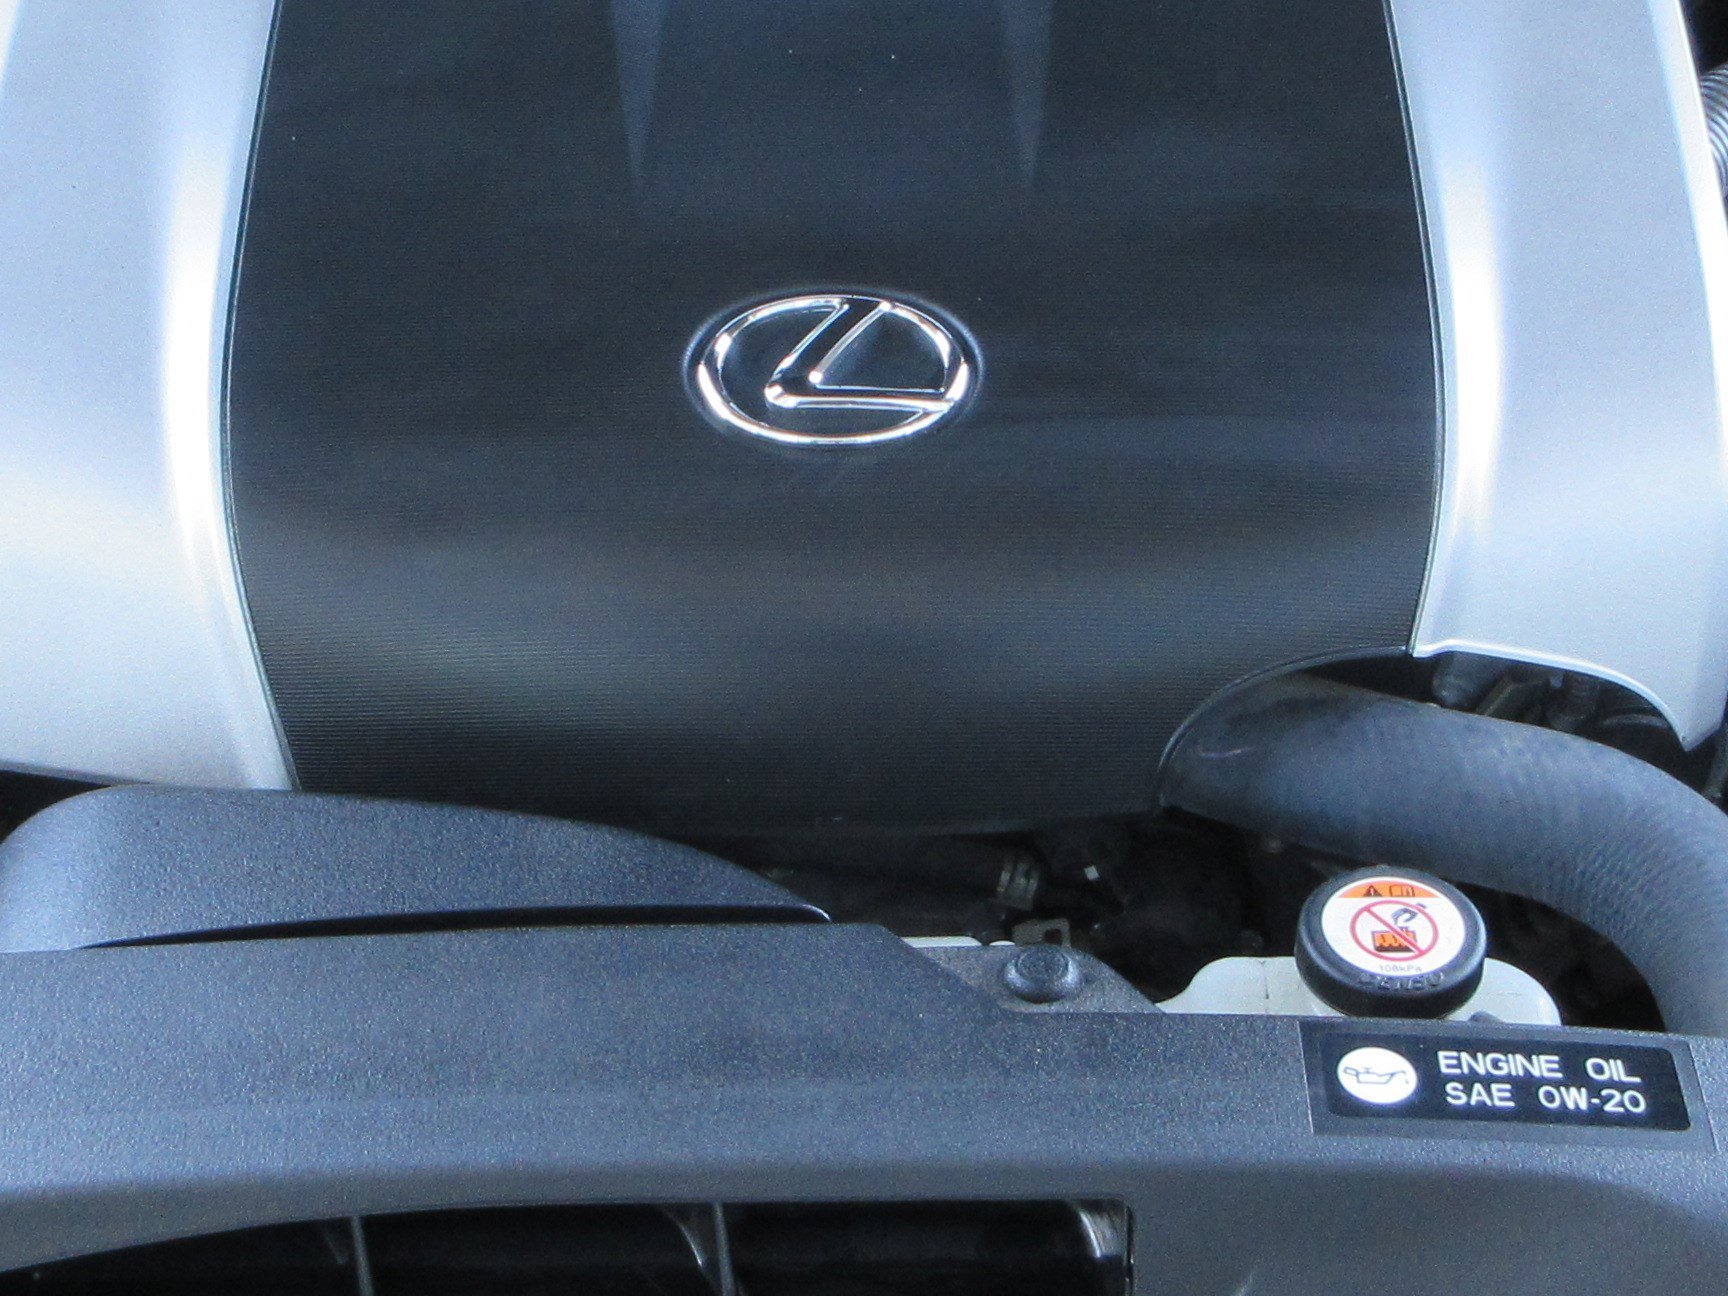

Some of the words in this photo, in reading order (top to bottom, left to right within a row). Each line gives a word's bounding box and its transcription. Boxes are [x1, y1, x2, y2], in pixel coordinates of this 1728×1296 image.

[1438, 1050, 1563, 1081] ENGINE
[1586, 1057, 1642, 1084] OIL
[1445, 1082, 1515, 1108] SAE
[1538, 1086, 1646, 1115] 0W-20
